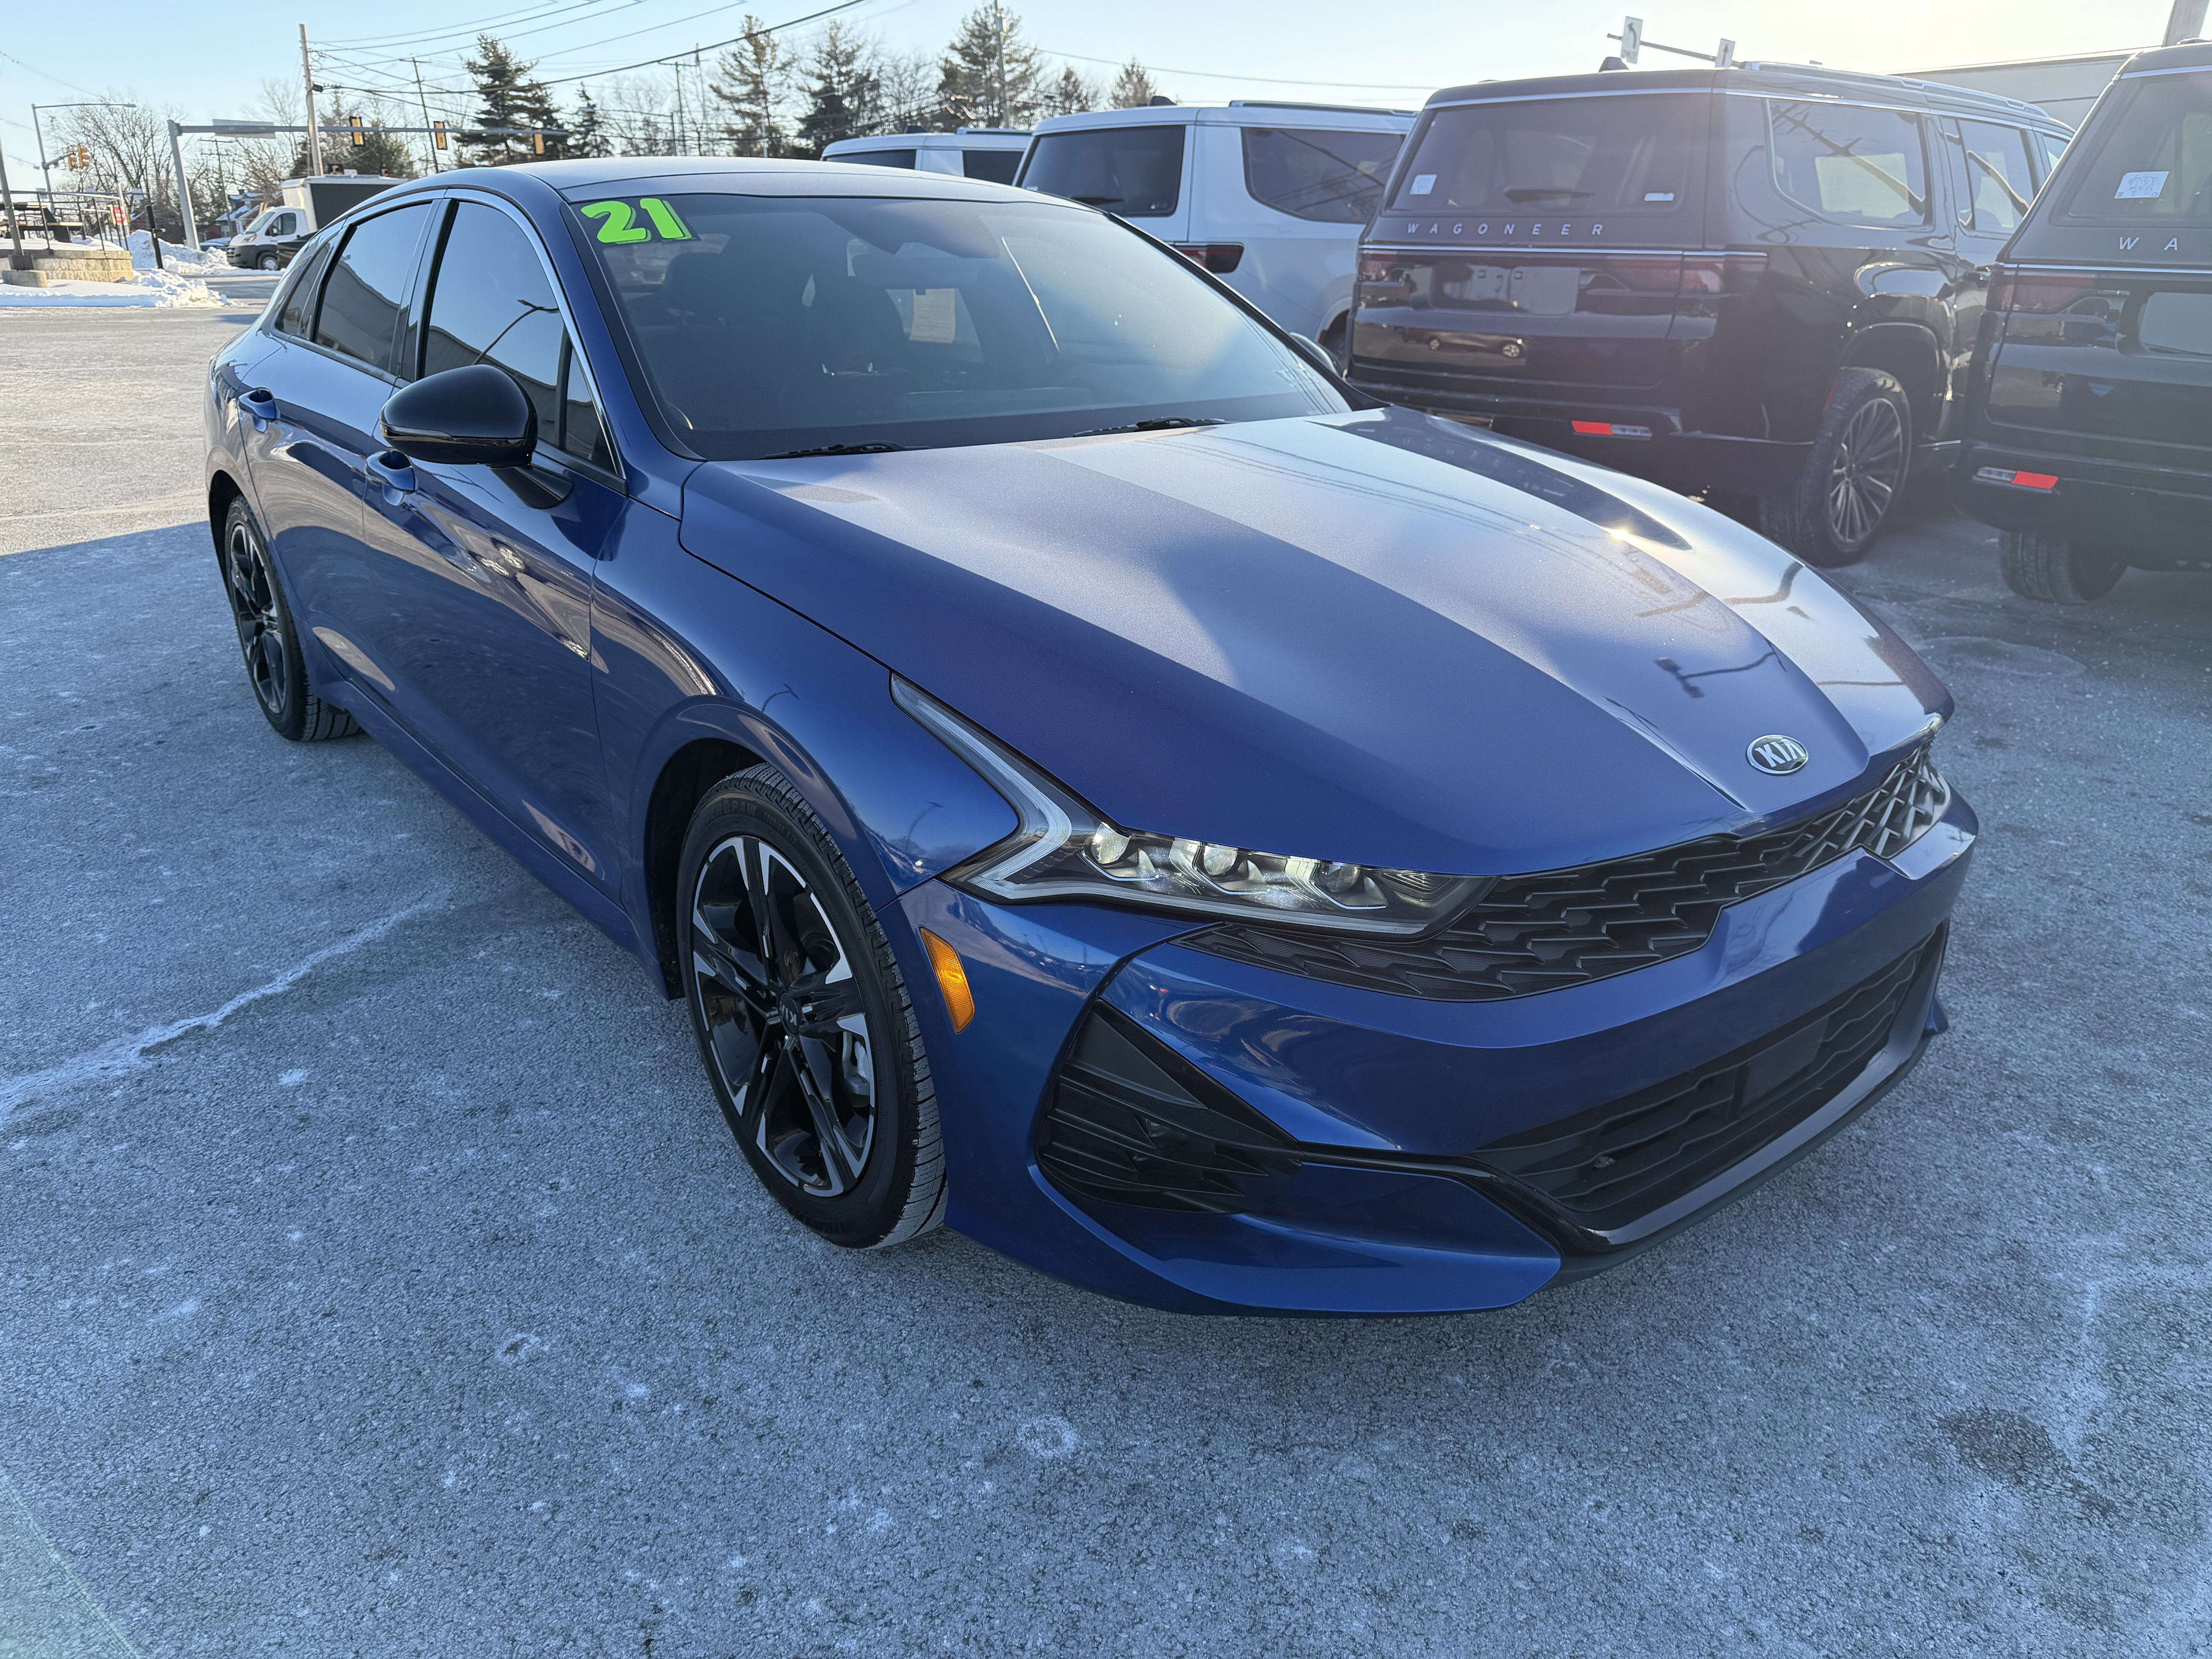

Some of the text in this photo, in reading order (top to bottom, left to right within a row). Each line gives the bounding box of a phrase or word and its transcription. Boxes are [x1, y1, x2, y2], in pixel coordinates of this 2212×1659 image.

[581, 198, 692, 244] 21
[1408, 223, 1603, 235] WAGONEER
[1755, 739, 1805, 767] KIA
[780, 1001, 797, 1027] KIA
